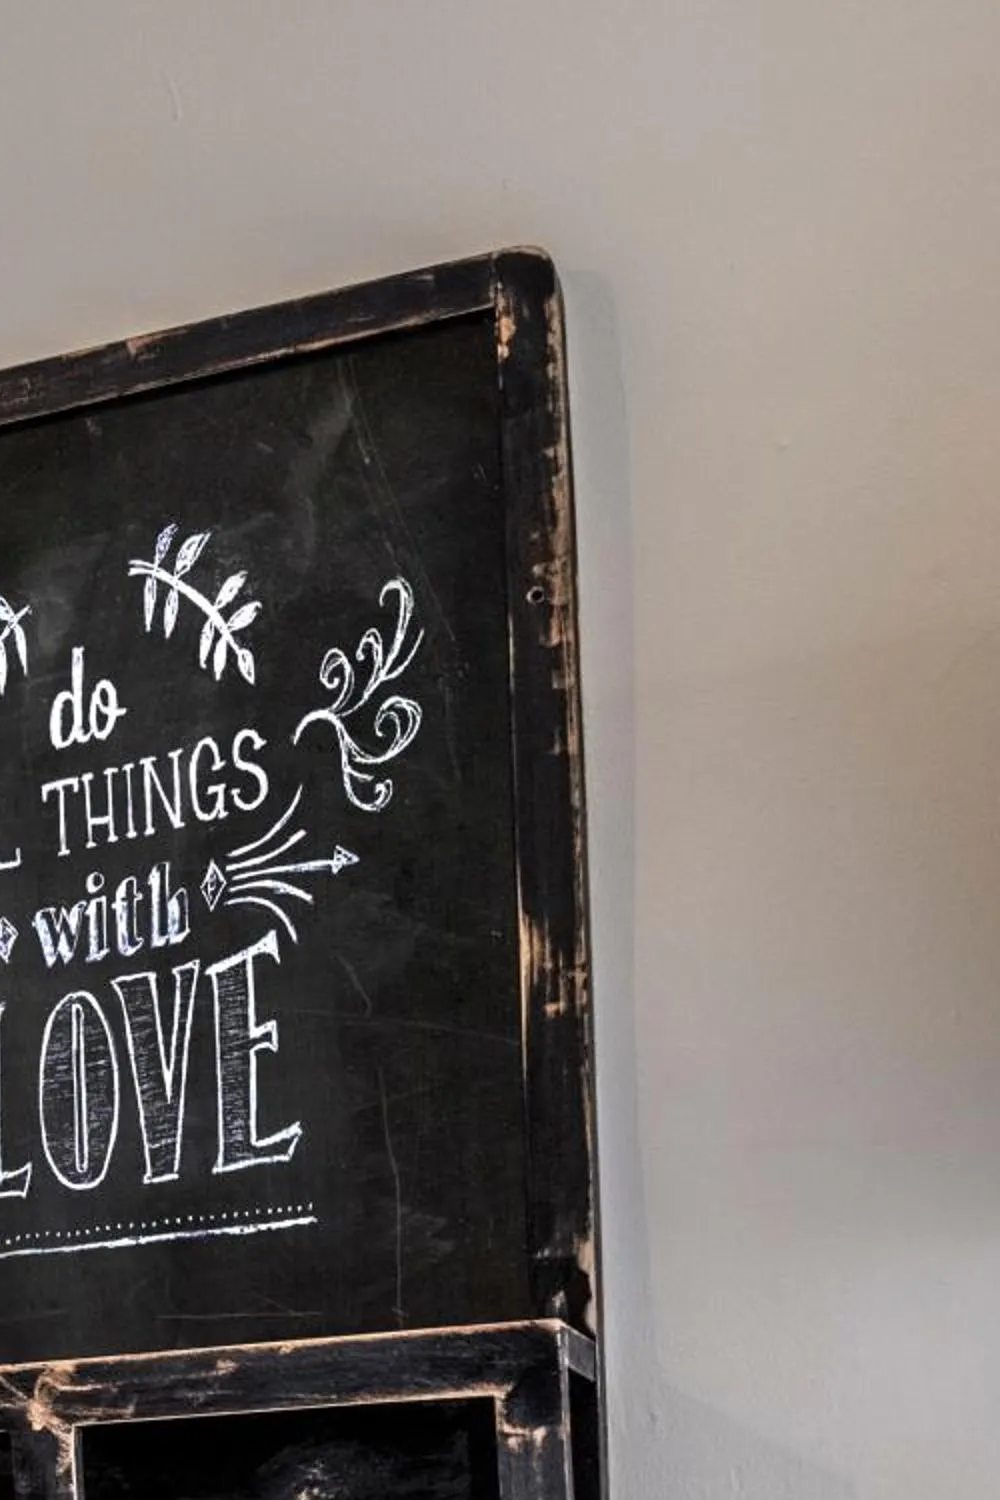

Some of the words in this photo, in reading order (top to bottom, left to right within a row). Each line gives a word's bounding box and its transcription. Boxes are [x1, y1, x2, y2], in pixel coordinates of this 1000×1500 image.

[49, 646, 126, 749] do
[41, 728, 270, 857] THINGS
[32, 861, 192, 968] with
